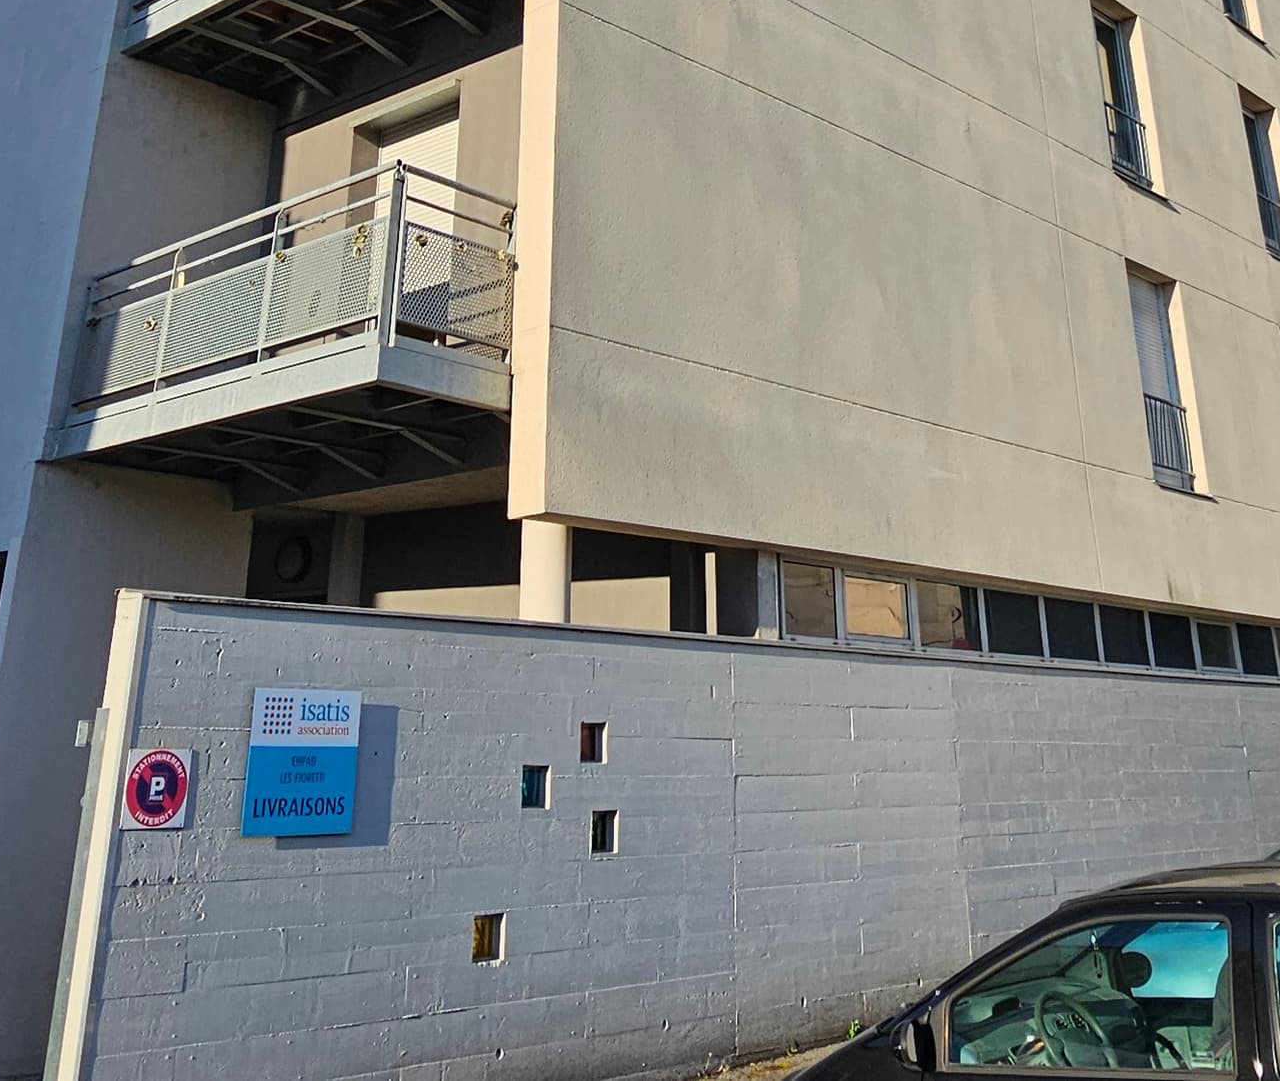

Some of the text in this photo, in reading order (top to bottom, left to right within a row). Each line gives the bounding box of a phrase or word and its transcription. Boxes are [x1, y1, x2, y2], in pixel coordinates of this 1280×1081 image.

[299, 697, 350, 722] isatis
[297, 722, 349, 736] association
[132, 753, 185, 779] STATIONNEMENT
[291, 755, 317, 768] EHPAD
[279, 771, 292, 784] LES
[252, 796, 345, 818] LIVRAISONS
[134, 809, 174, 825] INTERDIT
